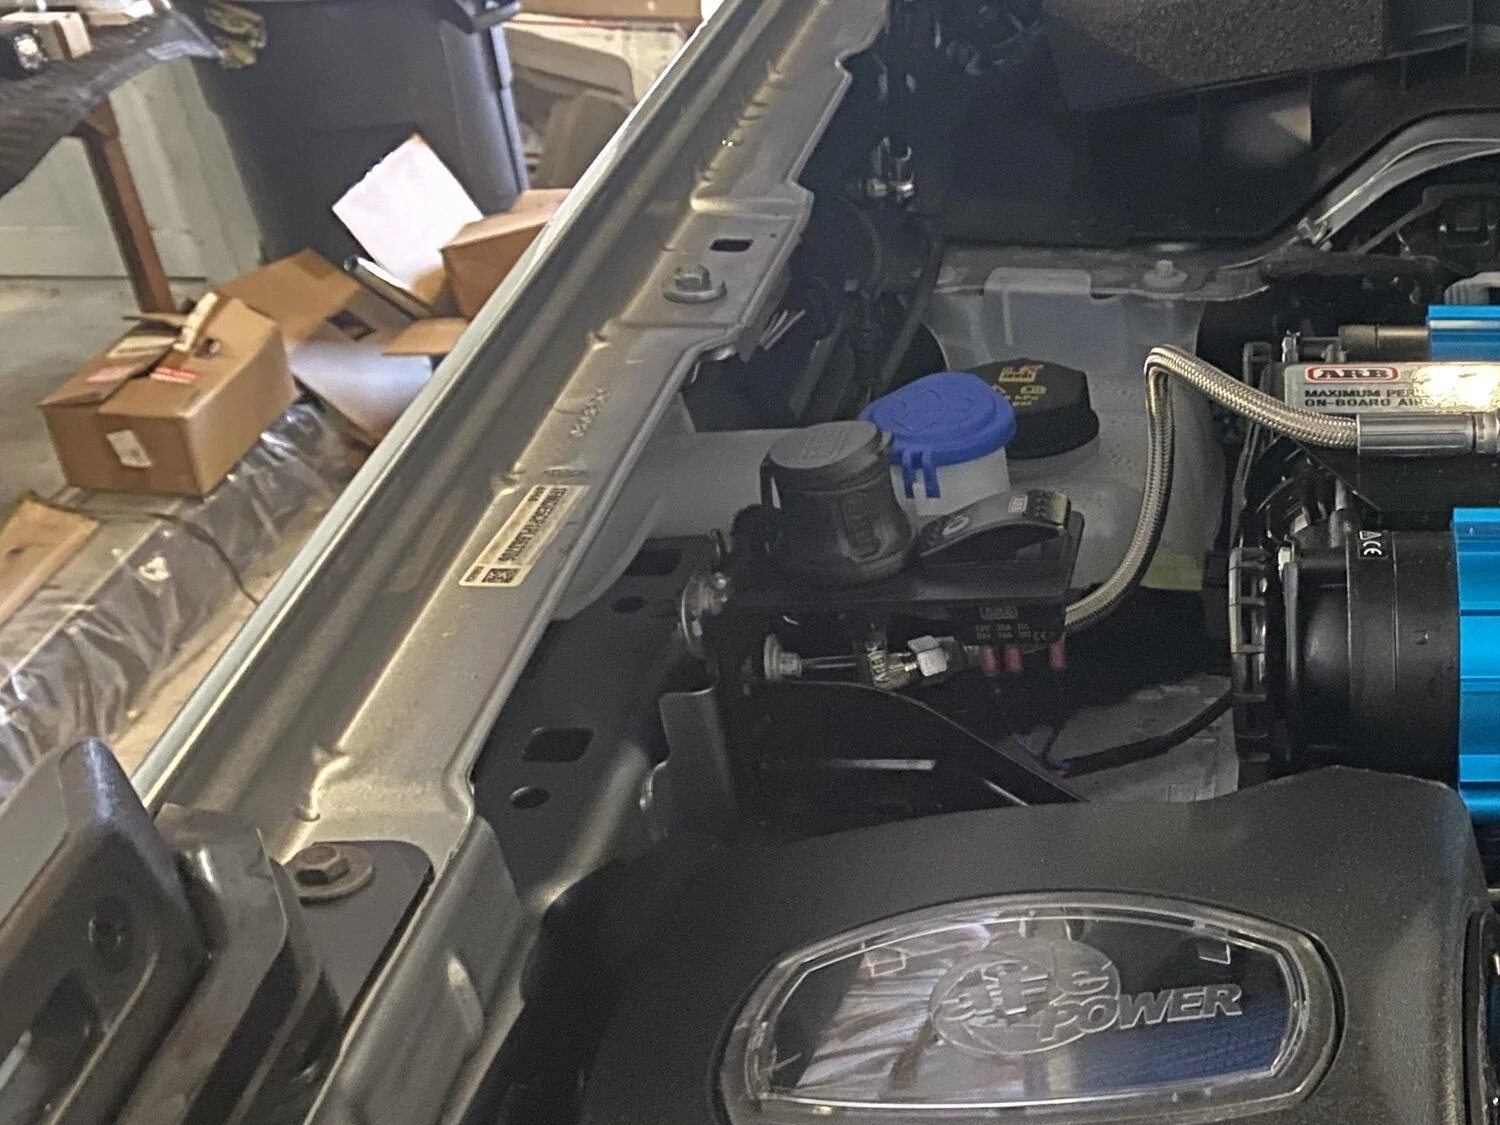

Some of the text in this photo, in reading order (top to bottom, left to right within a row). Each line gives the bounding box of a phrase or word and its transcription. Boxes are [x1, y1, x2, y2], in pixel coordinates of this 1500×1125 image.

[1304, 389, 1381, 398] MAXIMUM
[1304, 398, 1391, 407] ON-BOARD
[1037, 983, 1243, 1043] POWER
